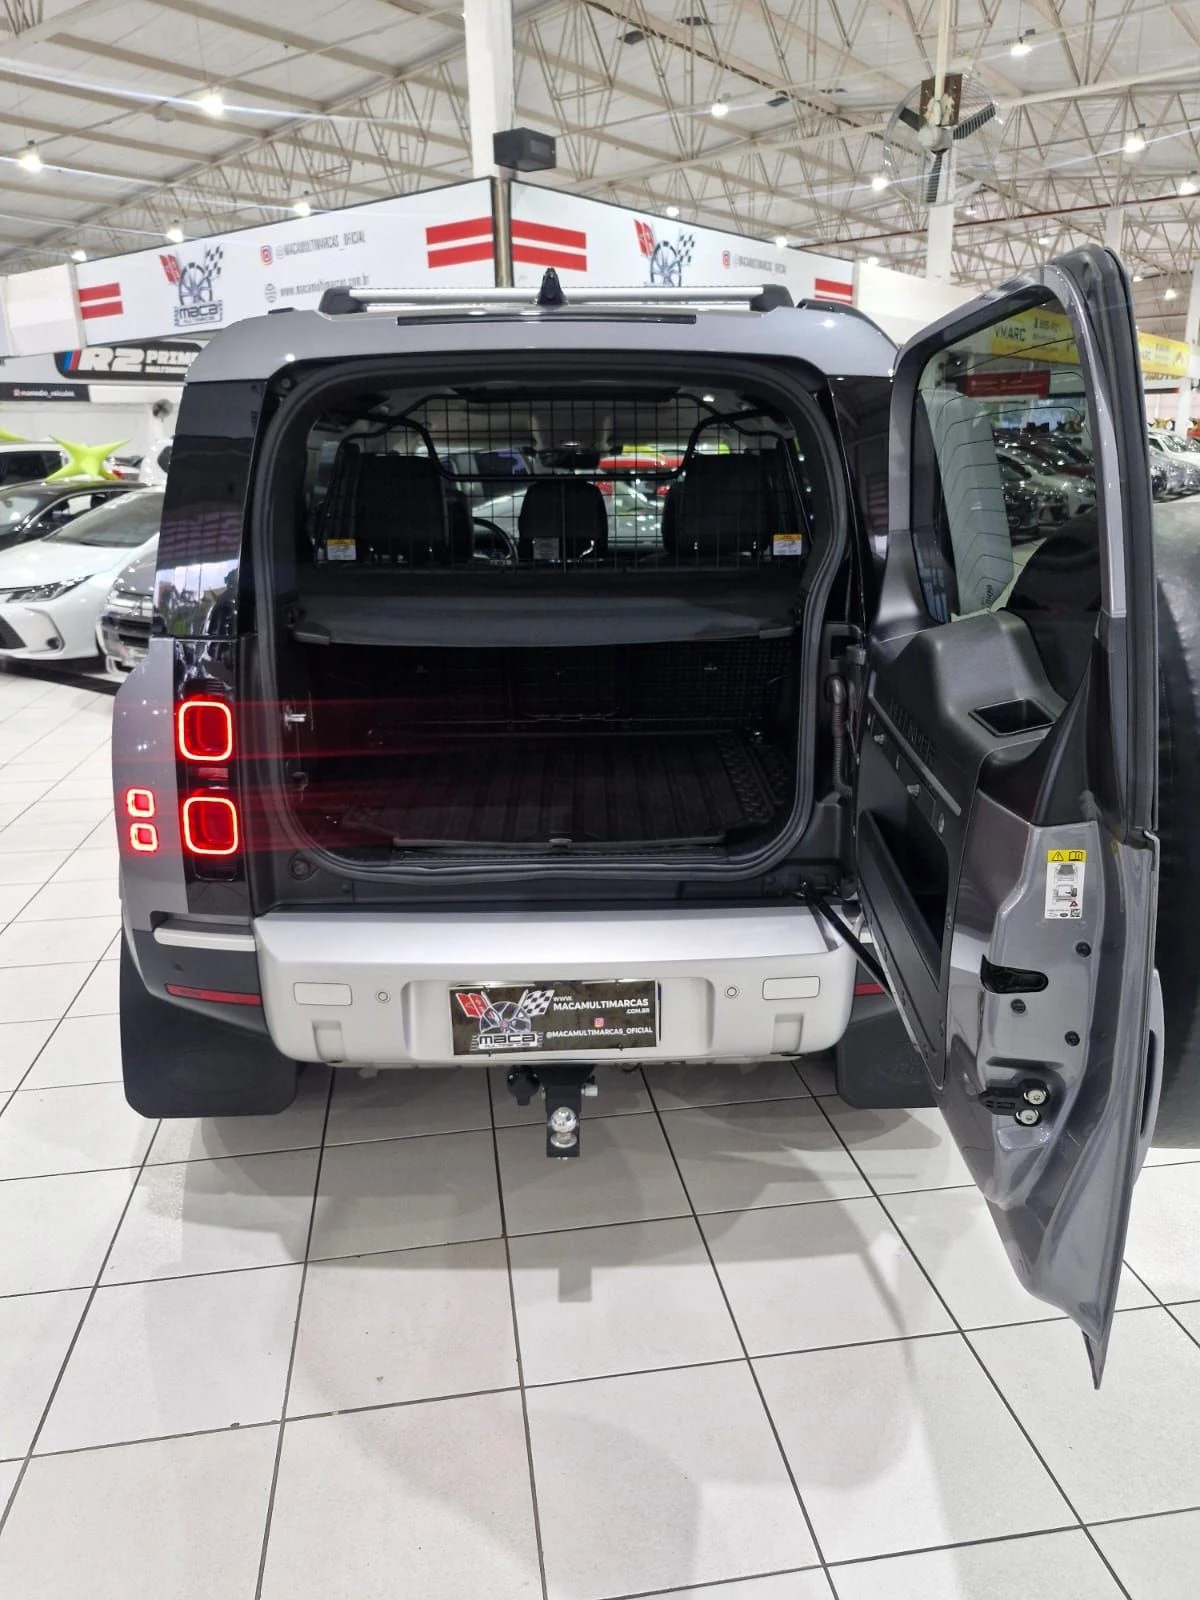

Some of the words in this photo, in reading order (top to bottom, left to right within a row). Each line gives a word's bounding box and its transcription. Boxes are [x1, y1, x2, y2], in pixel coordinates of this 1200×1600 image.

[77, 347, 144, 372] R2
[553, 998, 649, 1011] MACAMULTIMARCAS
[479, 1033, 536, 1045] maca
[546, 1026, 653, 1039] @MACAMULTIMARCAS_OFICIAL
